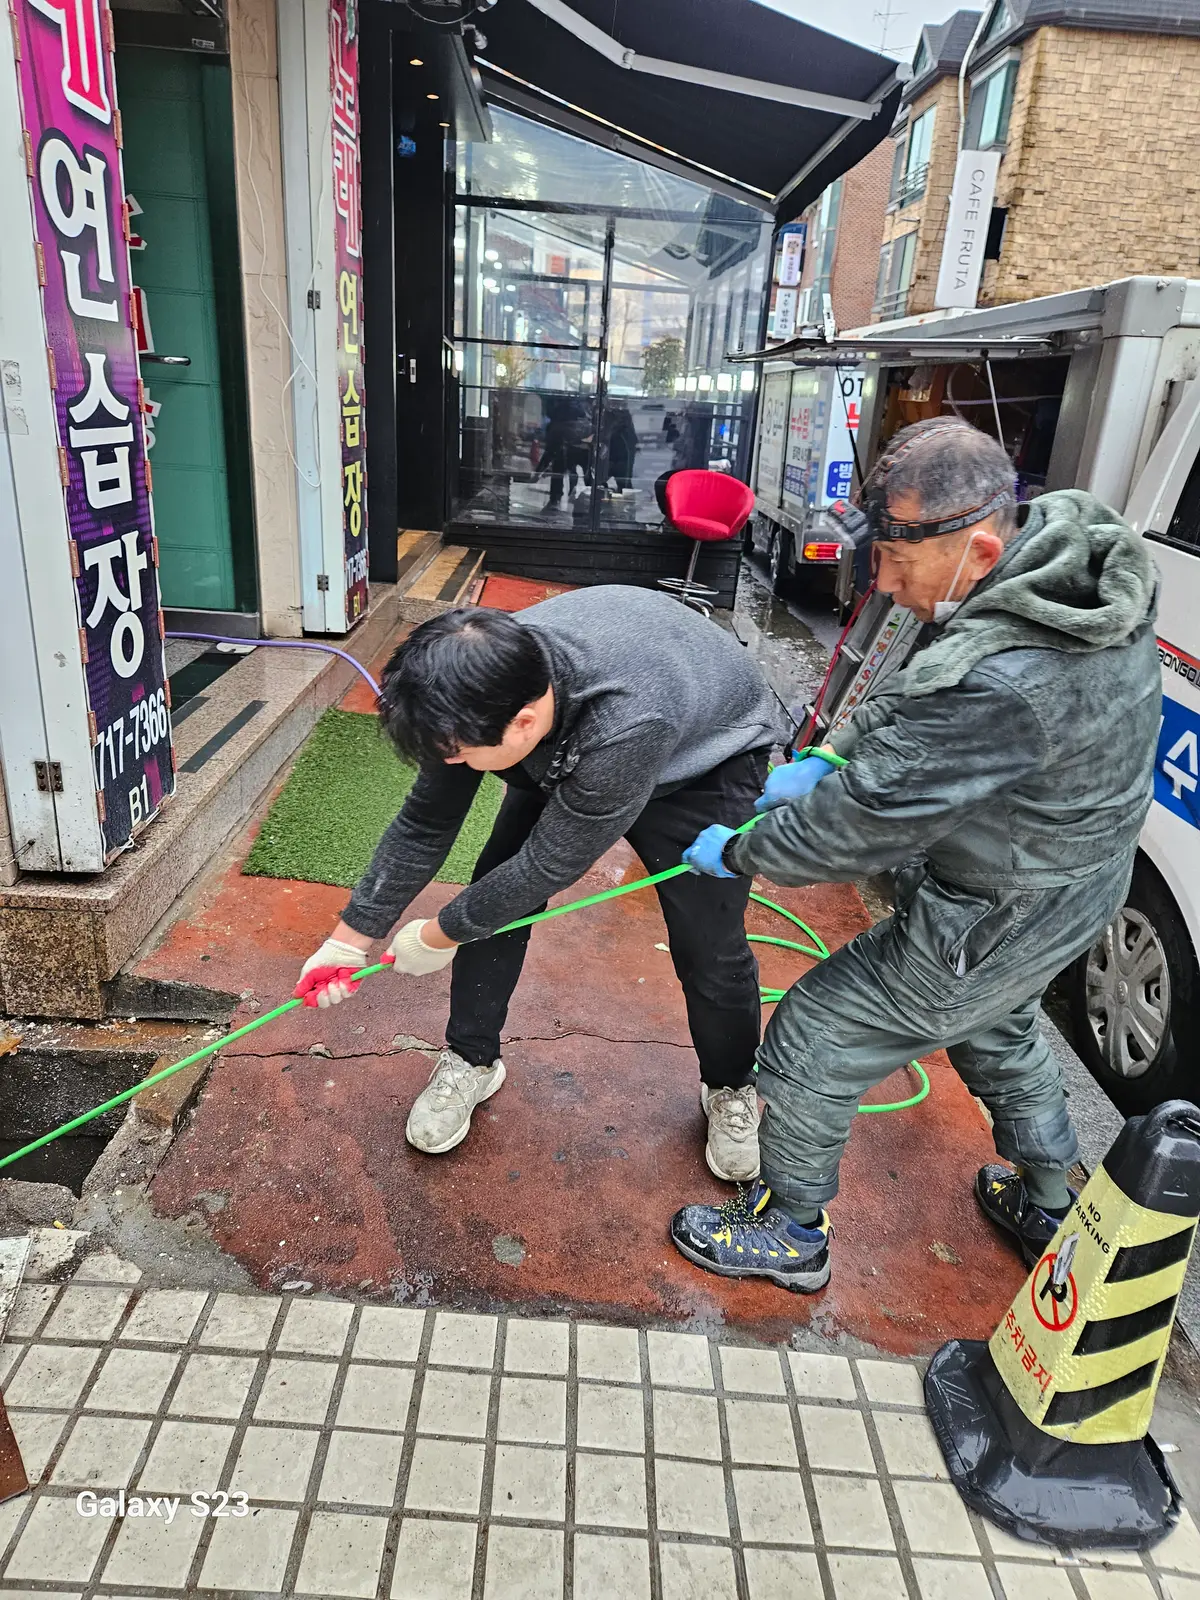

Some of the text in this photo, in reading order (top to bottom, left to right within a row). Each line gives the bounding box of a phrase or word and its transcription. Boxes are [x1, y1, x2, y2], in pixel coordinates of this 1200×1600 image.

[953, 169, 985, 290] CAFE FRUTA
[95, 687, 167, 791] 717-7366
[129, 773, 150, 827] B1
[1087, 1202, 1102, 1222] NO
[1005, 1308, 1053, 1392] 주차금지
